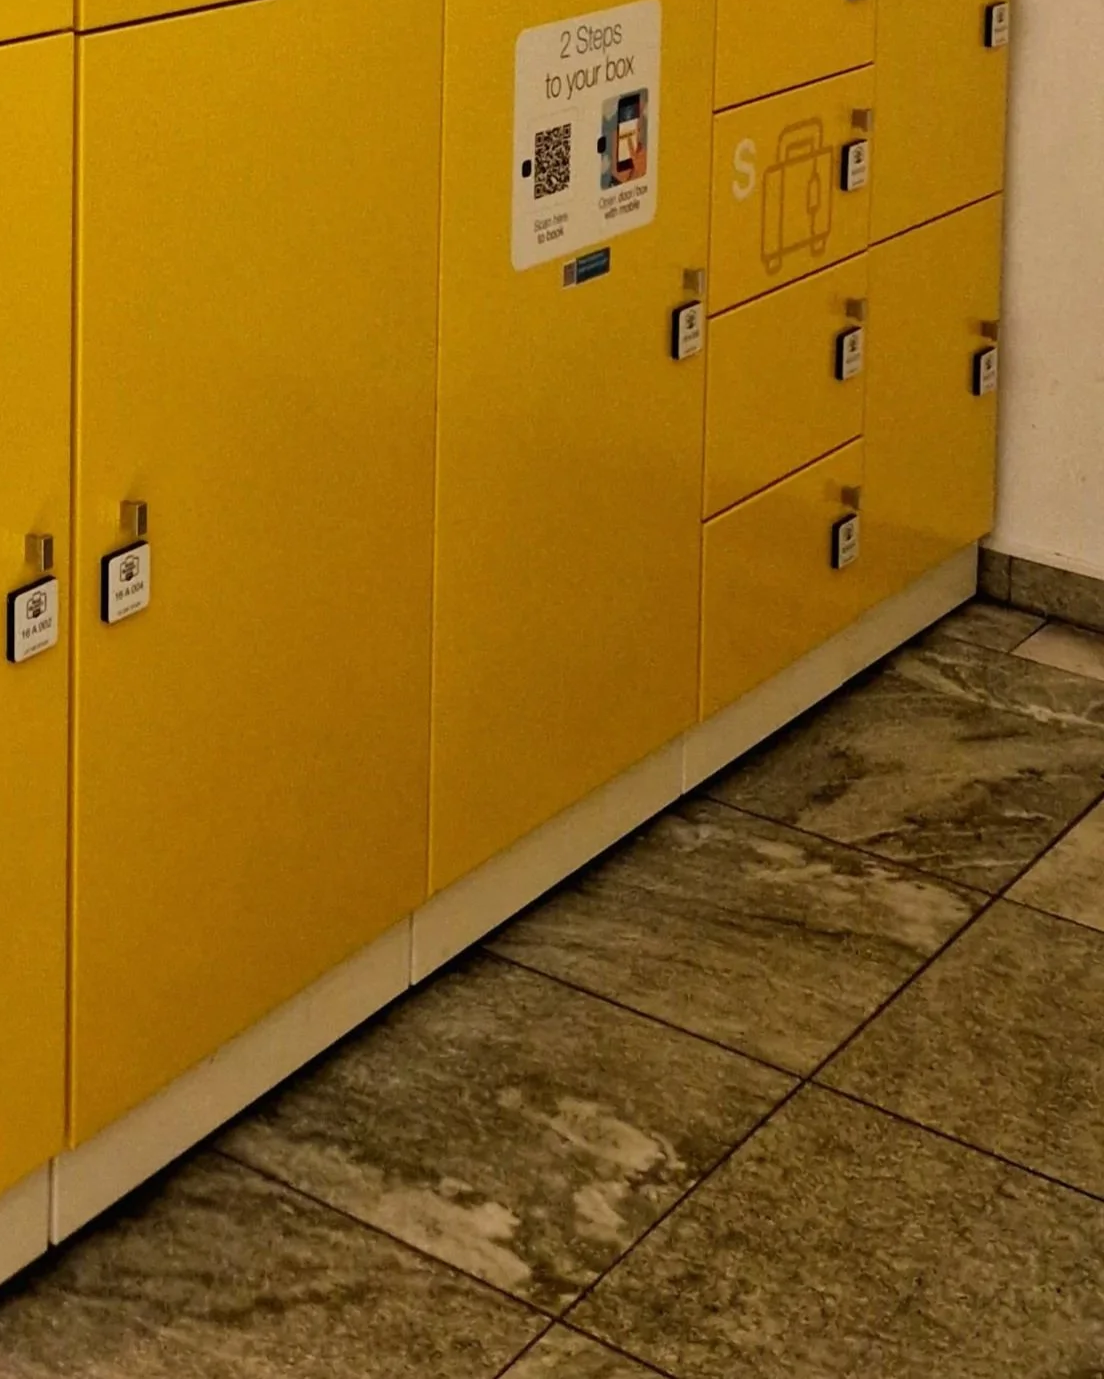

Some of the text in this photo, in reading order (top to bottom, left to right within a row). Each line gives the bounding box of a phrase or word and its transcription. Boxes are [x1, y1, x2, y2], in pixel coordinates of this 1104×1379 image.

[559, 23, 622, 59] 2 Steps
[546, 54, 634, 101] to your box
[731, 138, 756, 201] S
